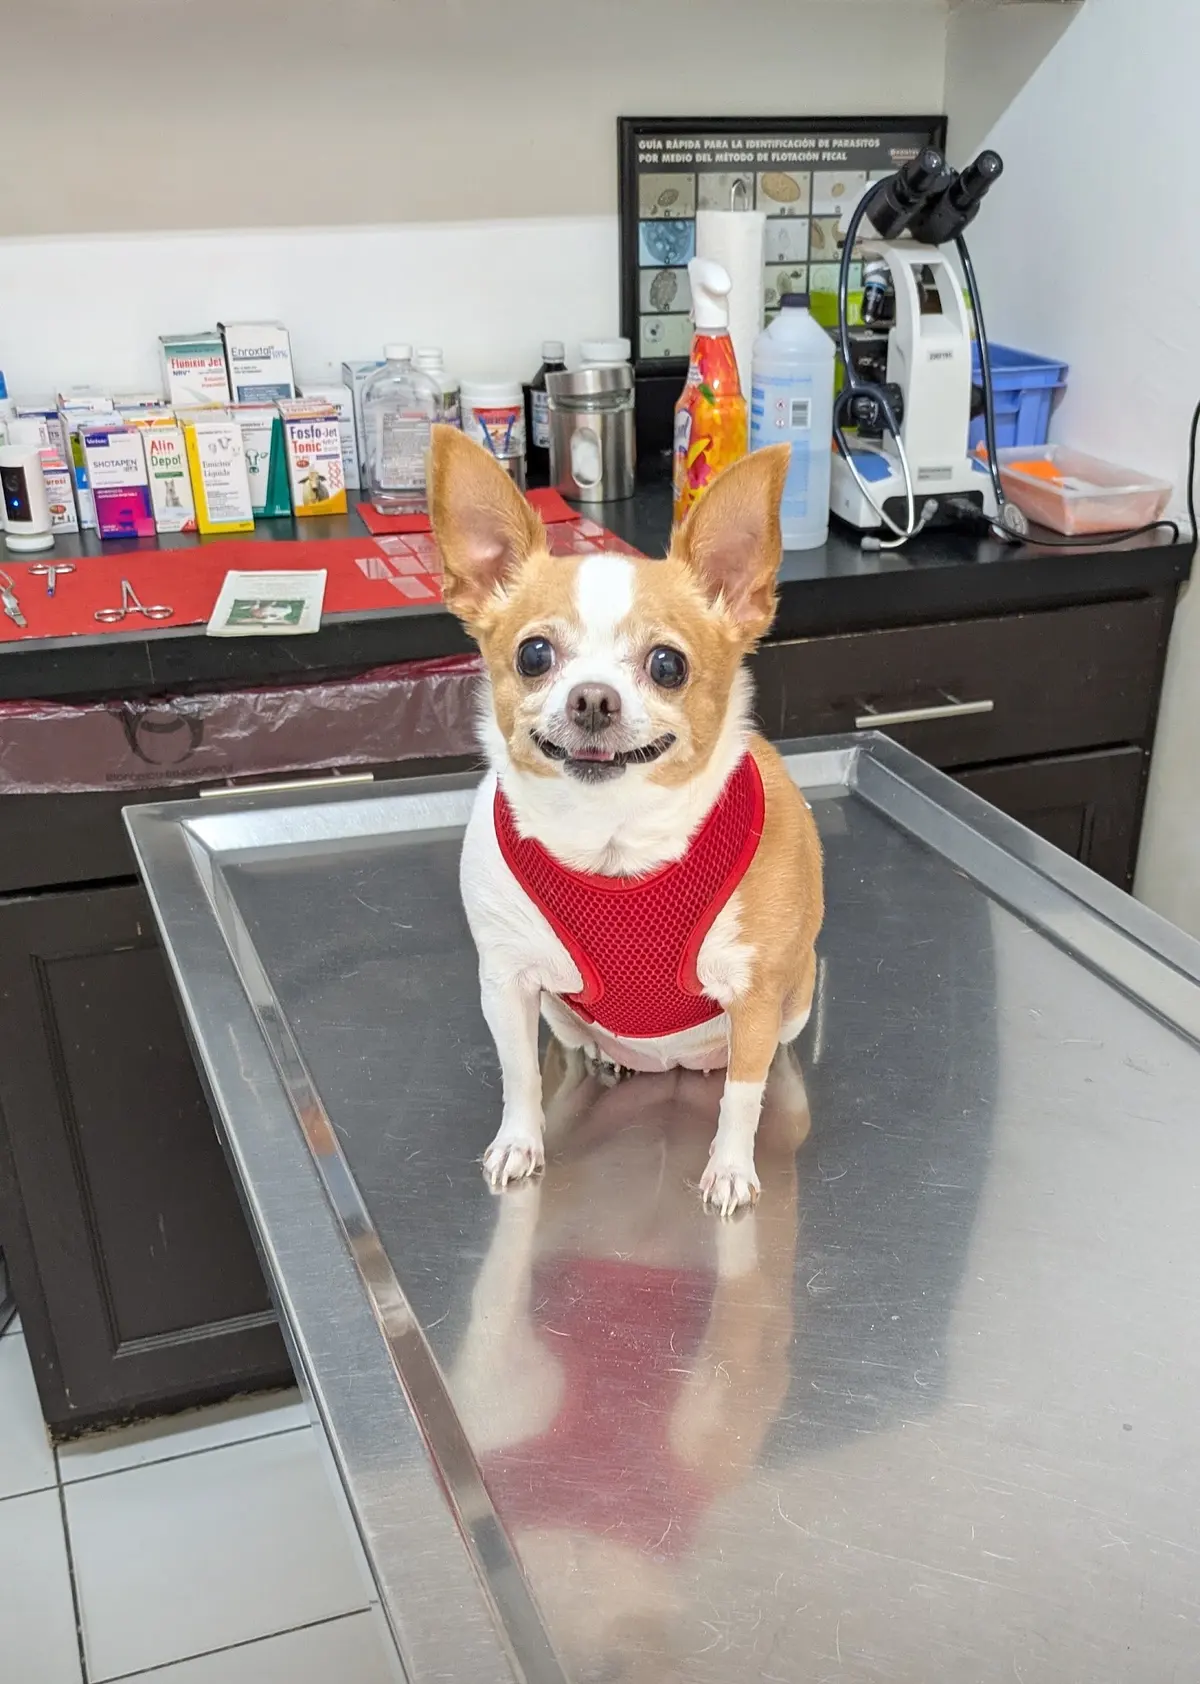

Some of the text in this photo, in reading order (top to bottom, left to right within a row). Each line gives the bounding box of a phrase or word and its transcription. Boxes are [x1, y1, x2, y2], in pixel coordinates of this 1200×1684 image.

[638, 138, 880, 150] GUÍA RÁPIDA PARA LA IDENTIFICACIÓN DE PARASITOS
[638, 151, 848, 164] POR MEDIO DEL MÉTODO DE FLOTACIÓN FECAL
[208, 357, 222, 367] Jet
[150, 440, 174, 454] Alin
[292, 440, 322, 454] Tonic
[93, 459, 137, 469] SHOTAPEN
